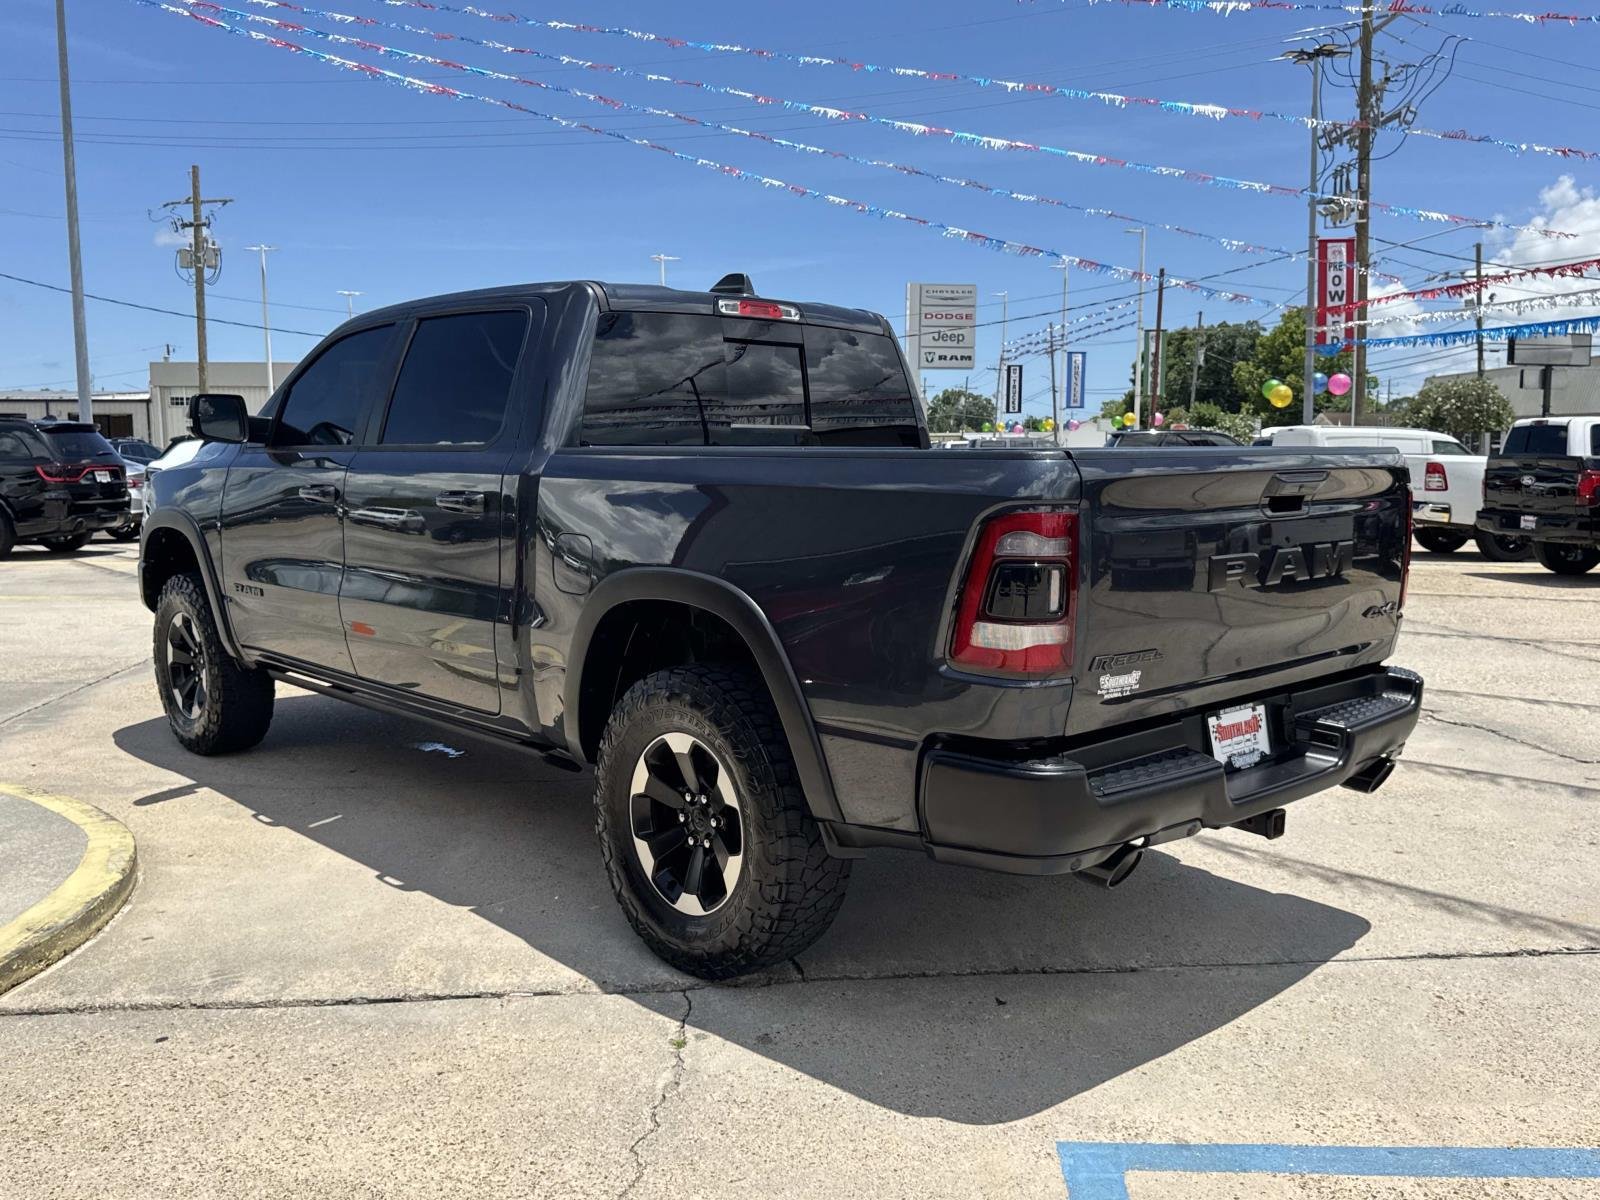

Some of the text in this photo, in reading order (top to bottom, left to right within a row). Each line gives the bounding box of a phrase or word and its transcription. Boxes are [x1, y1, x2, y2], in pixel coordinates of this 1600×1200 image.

[1328, 262, 1344, 272] PRE
[924, 312, 973, 320] DODGE
[932, 329, 965, 345] Jeep
[1208, 540, 1354, 592] RAM
[233, 582, 264, 597] RAM
[1088, 648, 1166, 671] REBEL
[1216, 714, 1259, 742] SOUTHLAND
